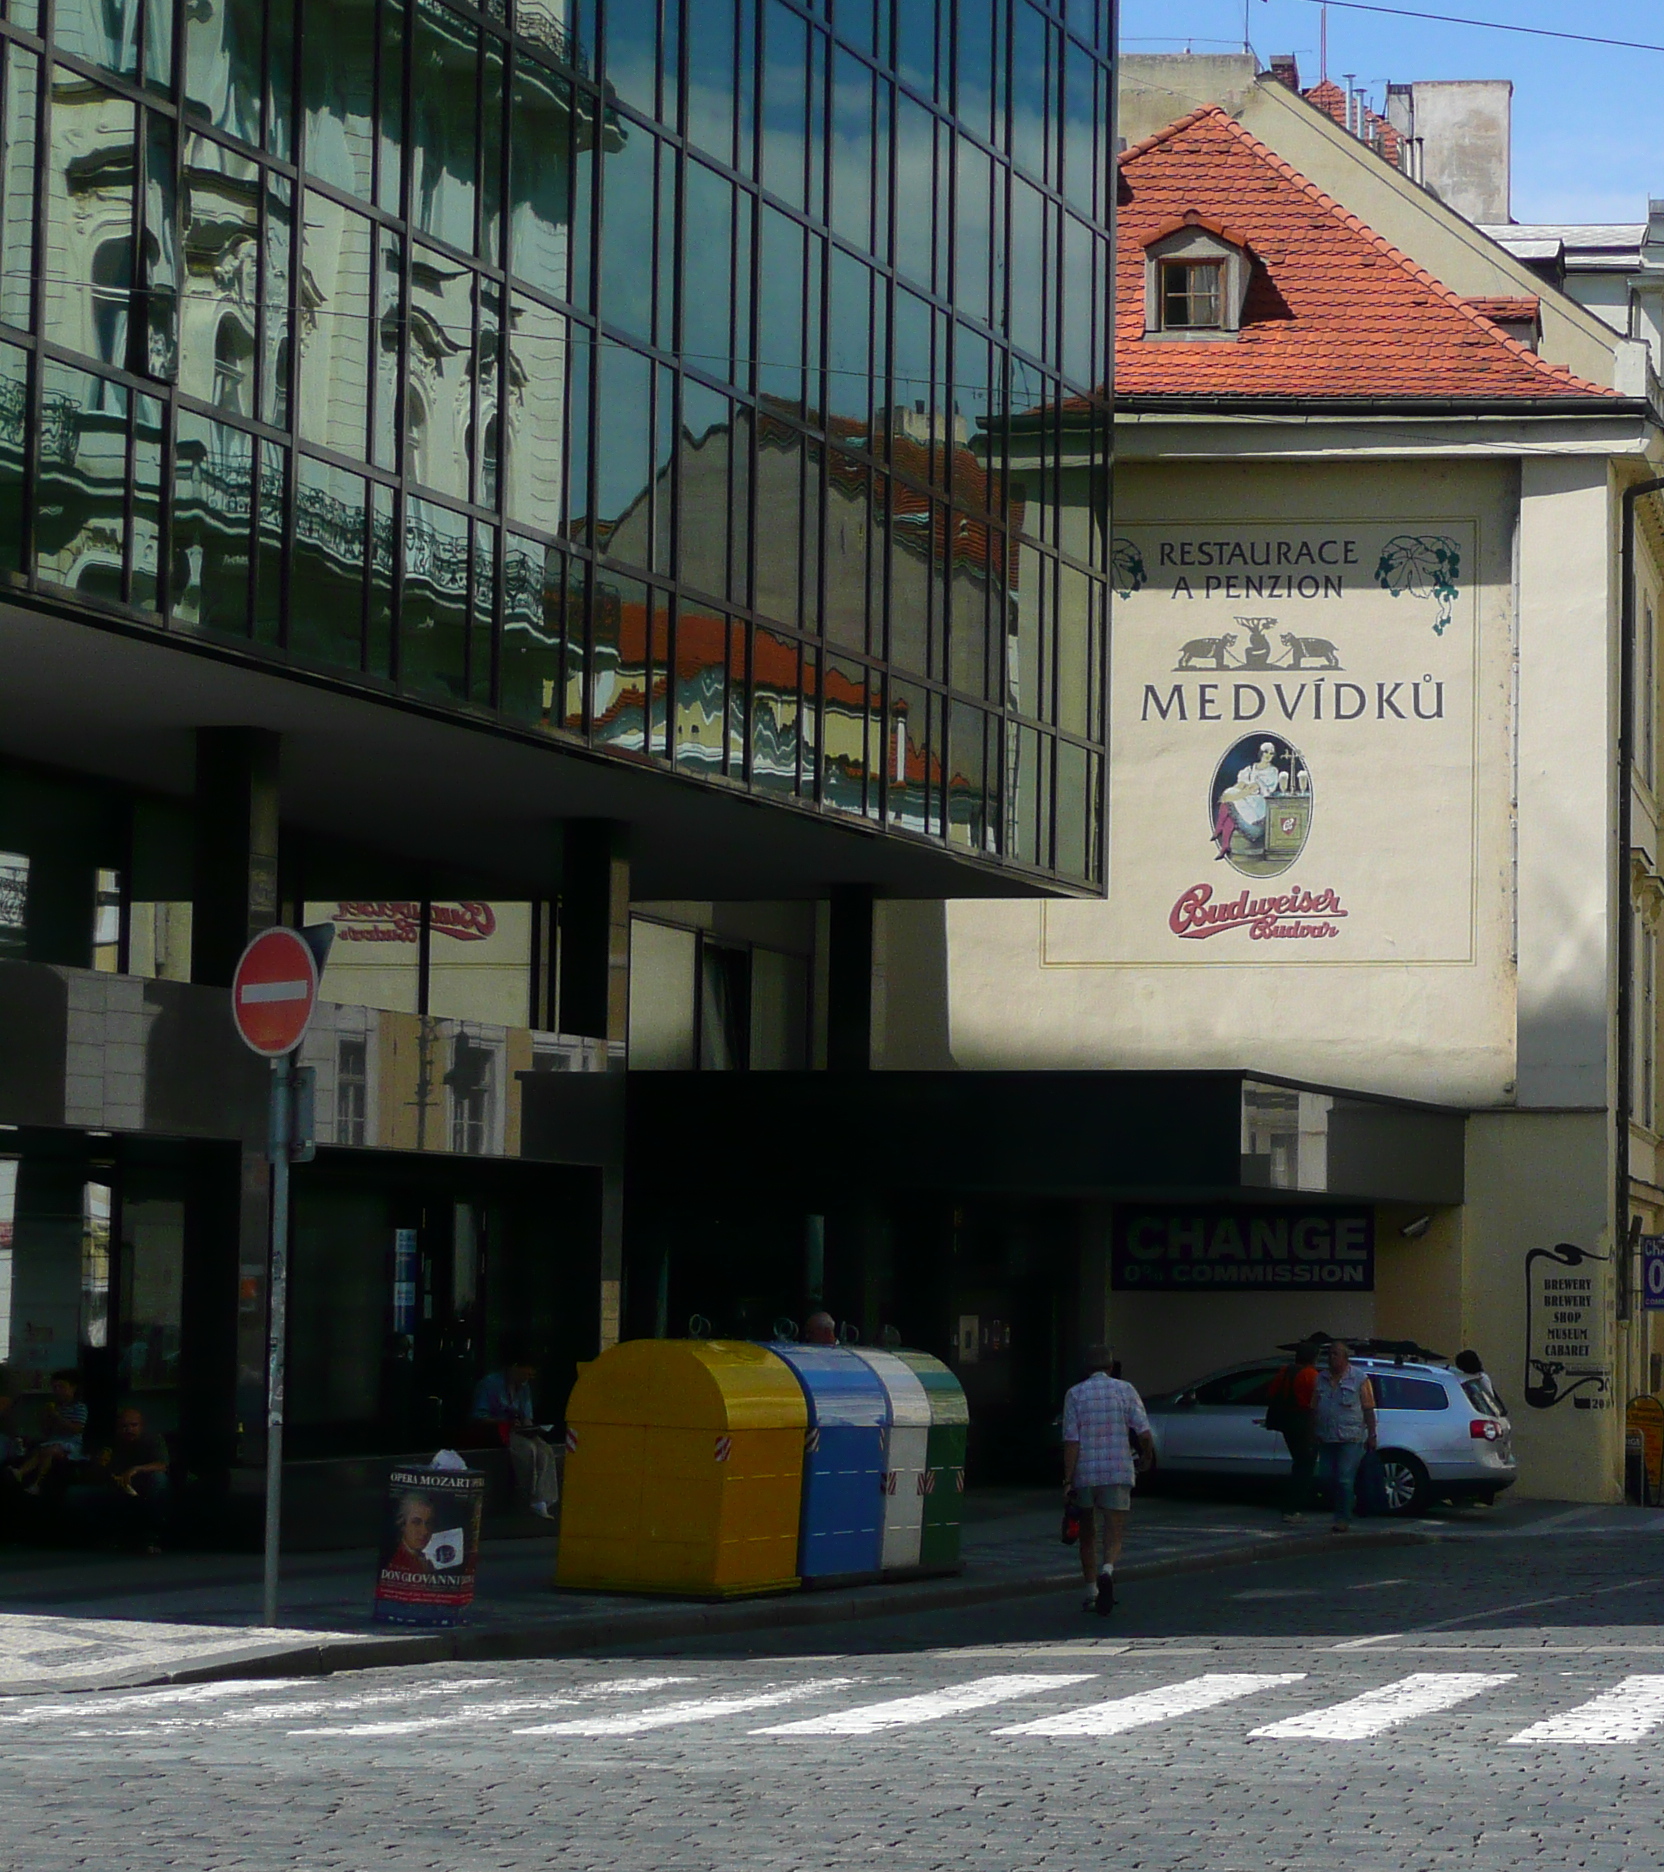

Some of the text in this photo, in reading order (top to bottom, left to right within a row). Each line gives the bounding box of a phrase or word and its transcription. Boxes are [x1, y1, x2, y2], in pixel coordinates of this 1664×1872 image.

[1159, 539, 1359, 567] RESTAURACE
[1171, 575, 1344, 600] A PENZION
[1140, 673, 1445, 722] MEDVÍDKŮ
[1168, 883, 1349, 937] Budweiser
[1249, 915, 1339, 941] Budvar
[1126, 1216, 1368, 1261] CHANGE
[1171, 1264, 1365, 1282] COMMISSION
[1544, 1279, 1592, 1290] BREWERY
[1544, 1296, 1592, 1307] BREWERY
[1554, 1312, 1582, 1323] SHOP
[1547, 1328, 1588, 1340] MUSEUM
[1545, 1345, 1590, 1357] CABARET
[390, 1472, 418, 1485] OPERA
[420, 1475, 470, 1488] MOZART
[381, 1569, 401, 1581] DON
[402, 1573, 460, 1586] GIOVANNI
